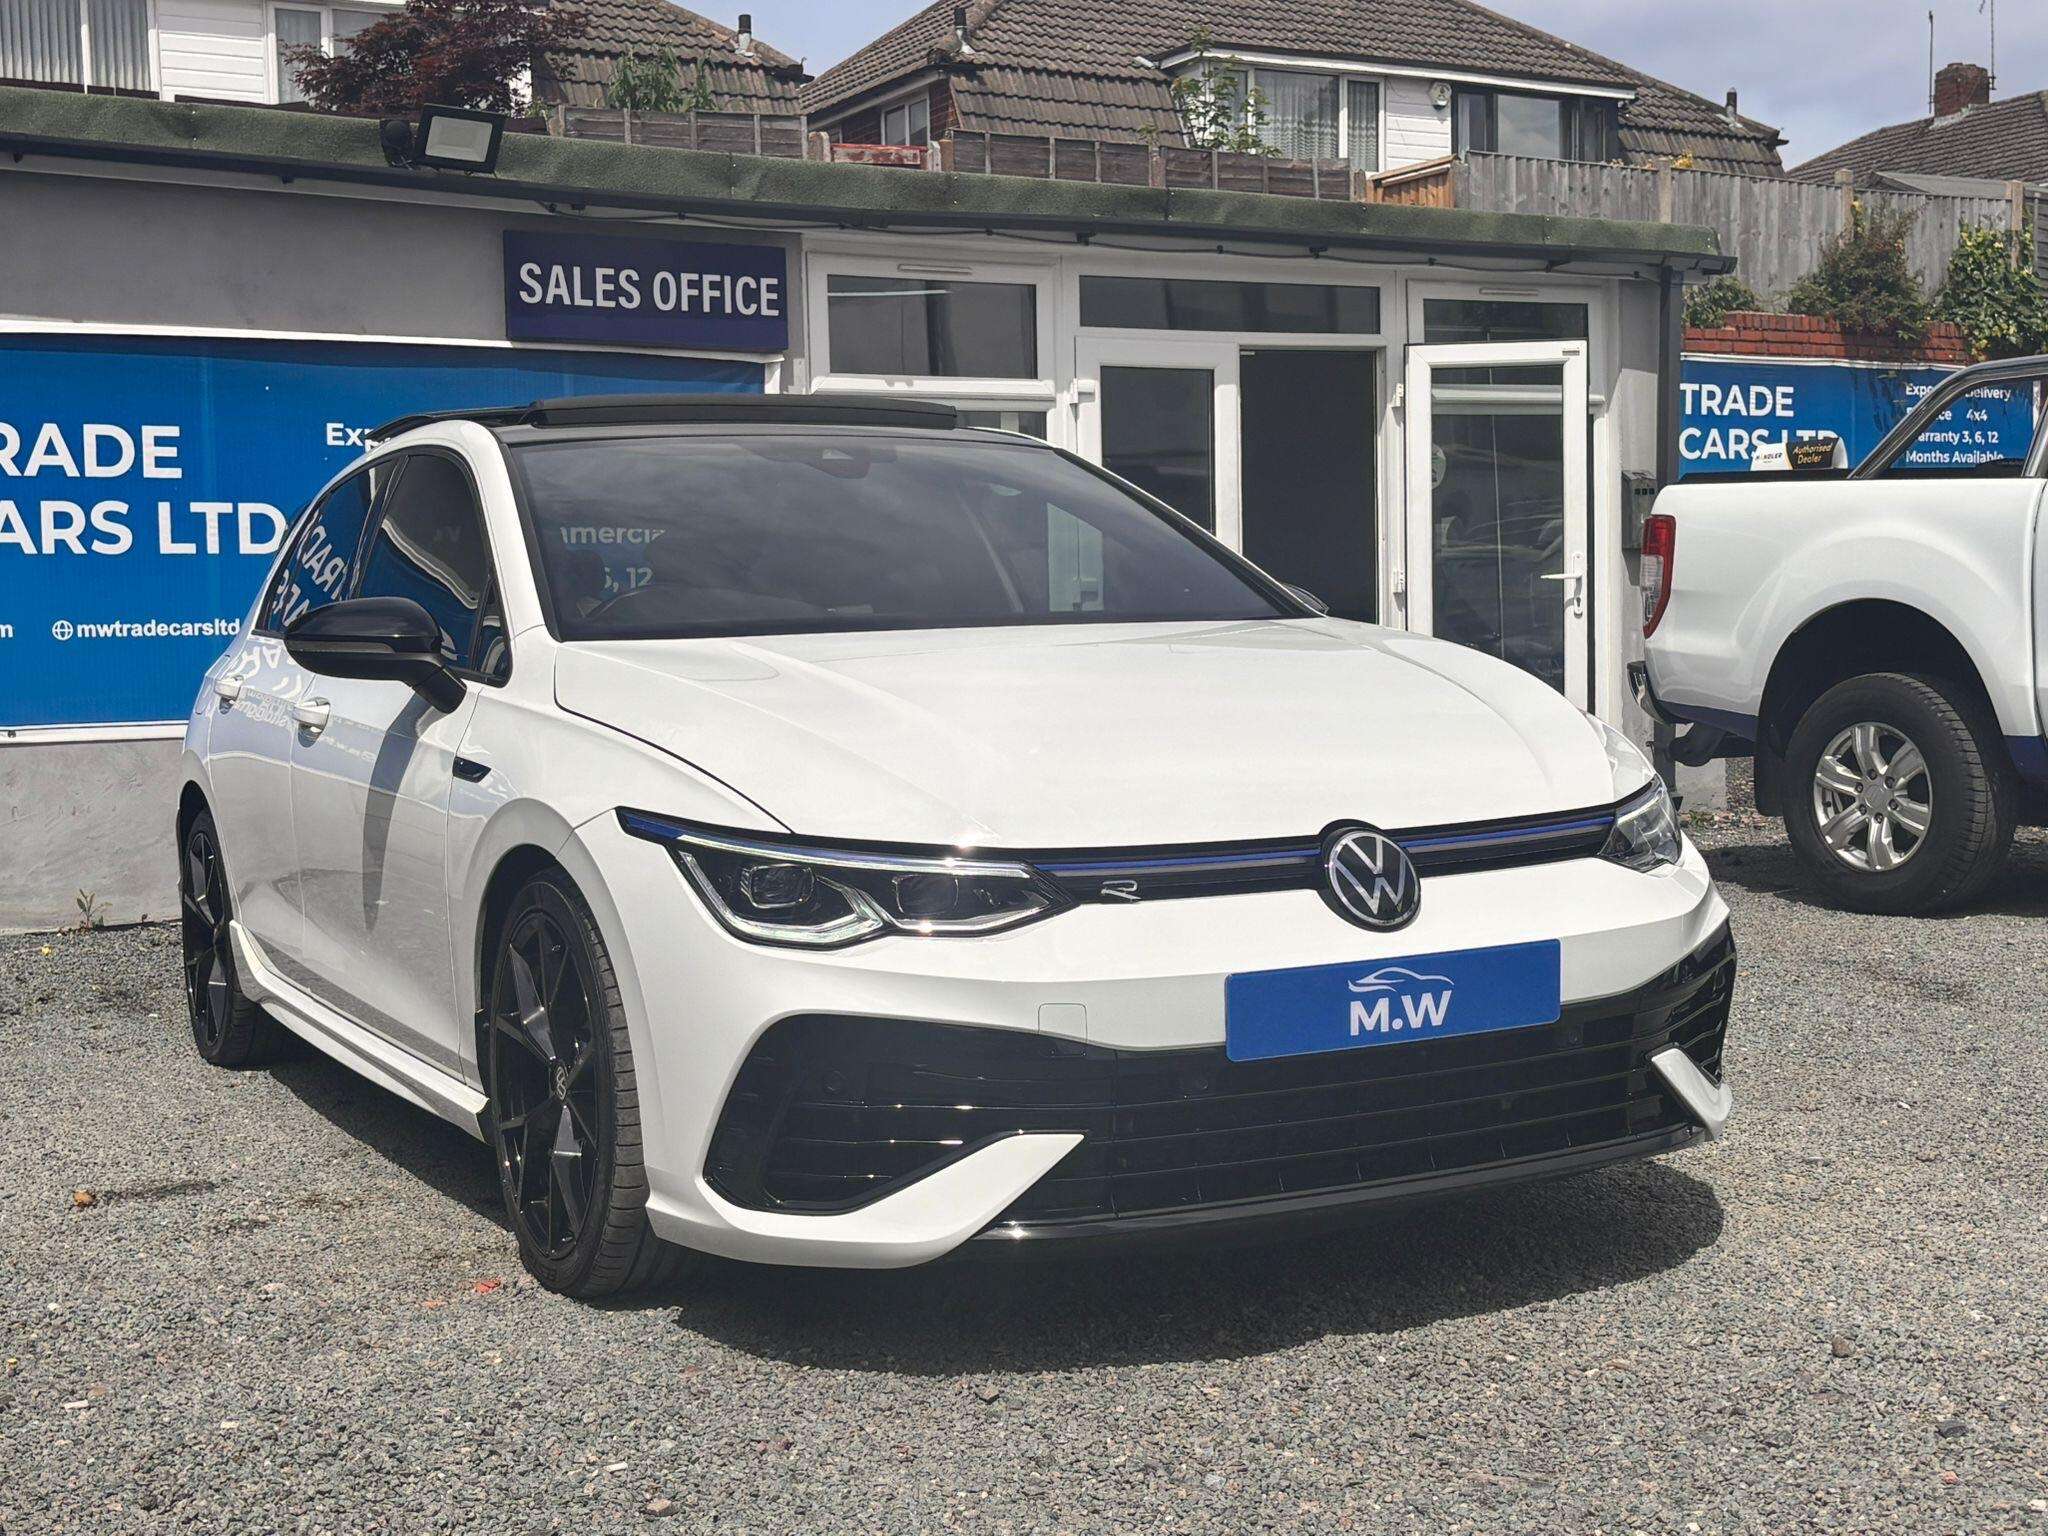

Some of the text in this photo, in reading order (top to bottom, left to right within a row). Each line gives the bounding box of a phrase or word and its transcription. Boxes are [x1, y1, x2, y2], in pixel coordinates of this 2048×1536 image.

[519, 262, 780, 317] SALES OFFICE
[1679, 382, 1794, 418] TRADE
[1966, 408, 1988, 422] 4x4
[1917, 431, 1999, 446] arranty 3, 6, 12
[1797, 452, 1822, 464] Dealer
[1906, 450, 1950, 464] Months
[157, 501, 288, 555] LTD
[77, 618, 241, 638] mwtradecarsltd
[1350, 990, 1453, 1037] M.W
